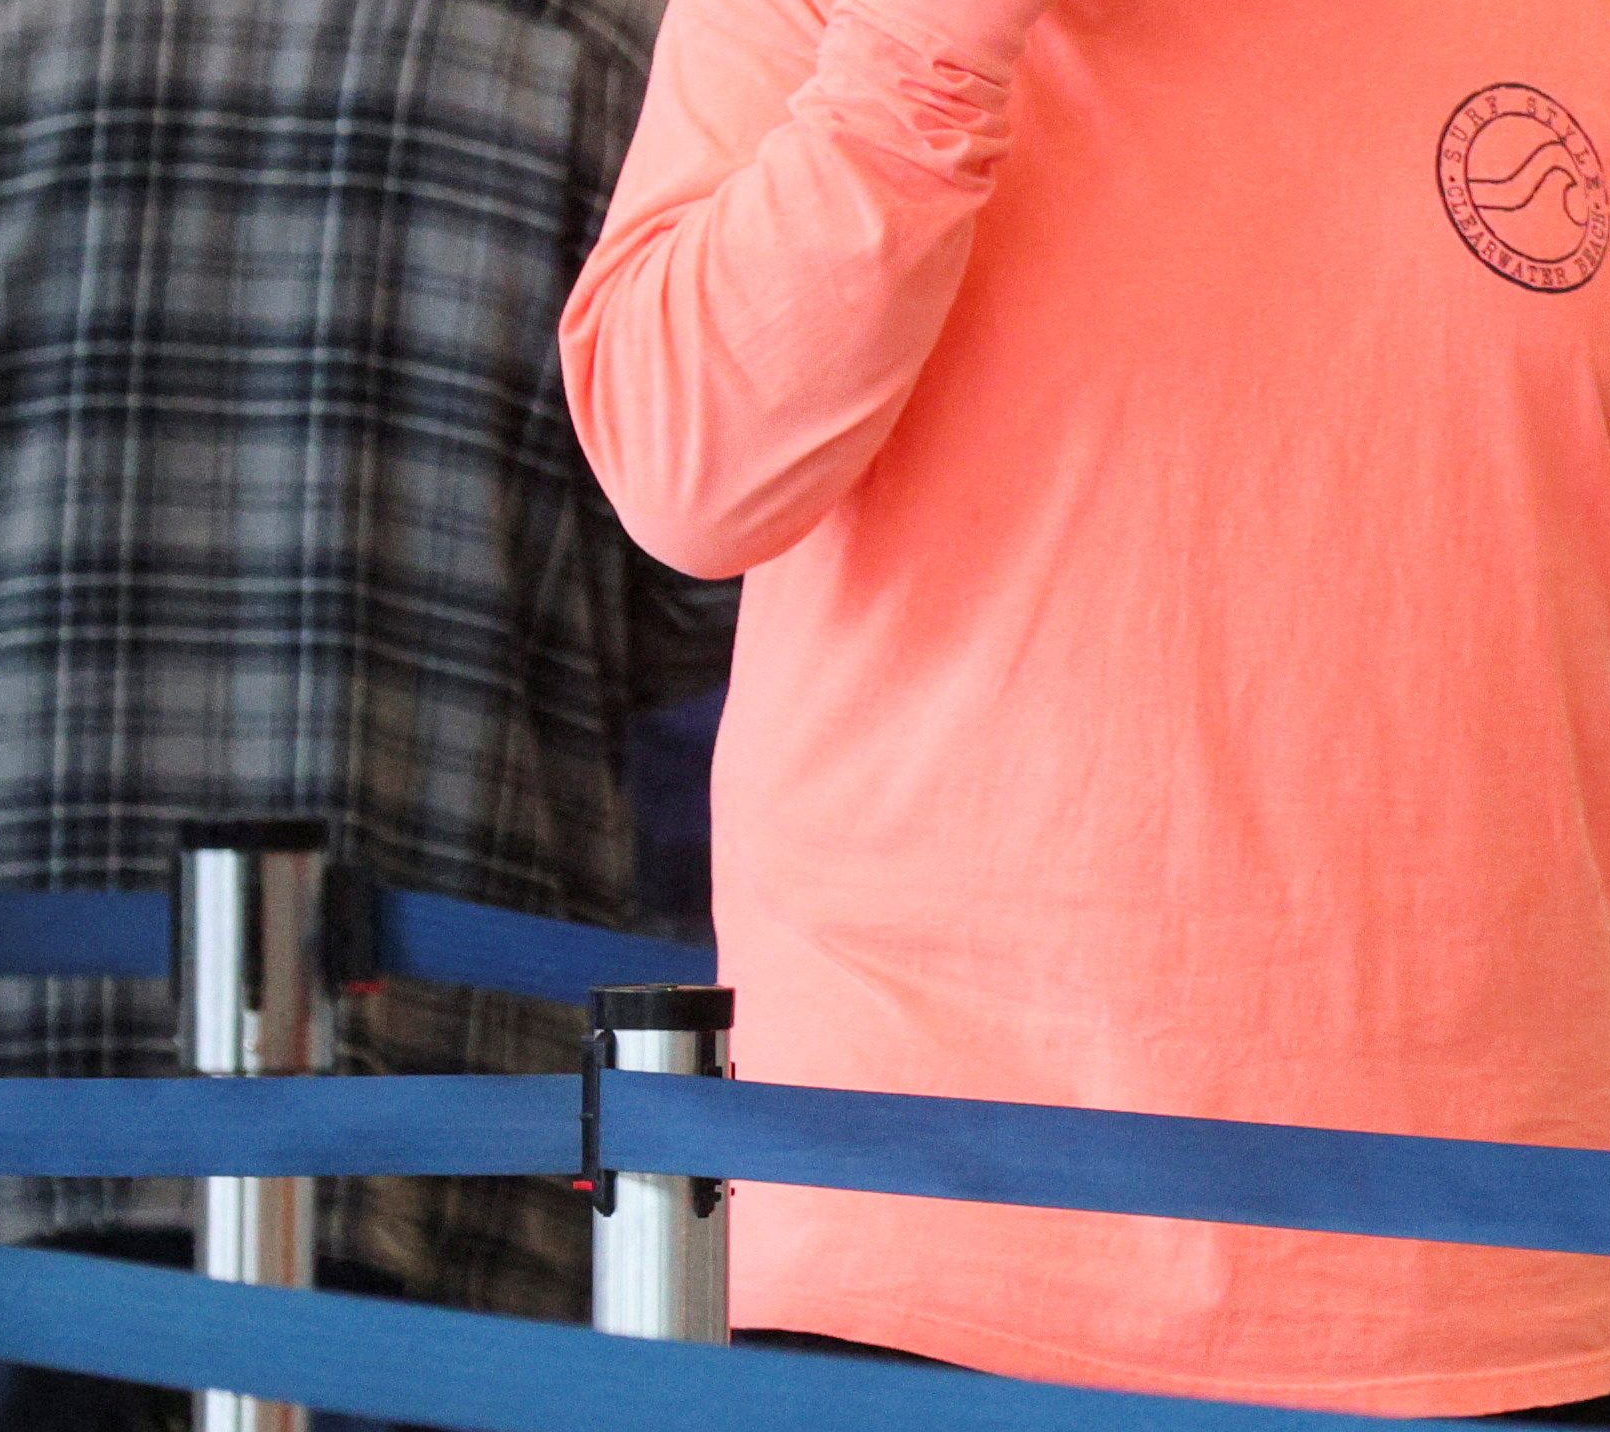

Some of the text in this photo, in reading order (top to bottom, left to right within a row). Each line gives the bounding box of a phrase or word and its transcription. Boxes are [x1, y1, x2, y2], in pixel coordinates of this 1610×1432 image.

[1443, 94, 1603, 191] SURF STYLE
[1446, 184, 1607, 286] CLEARWATER BEACH
